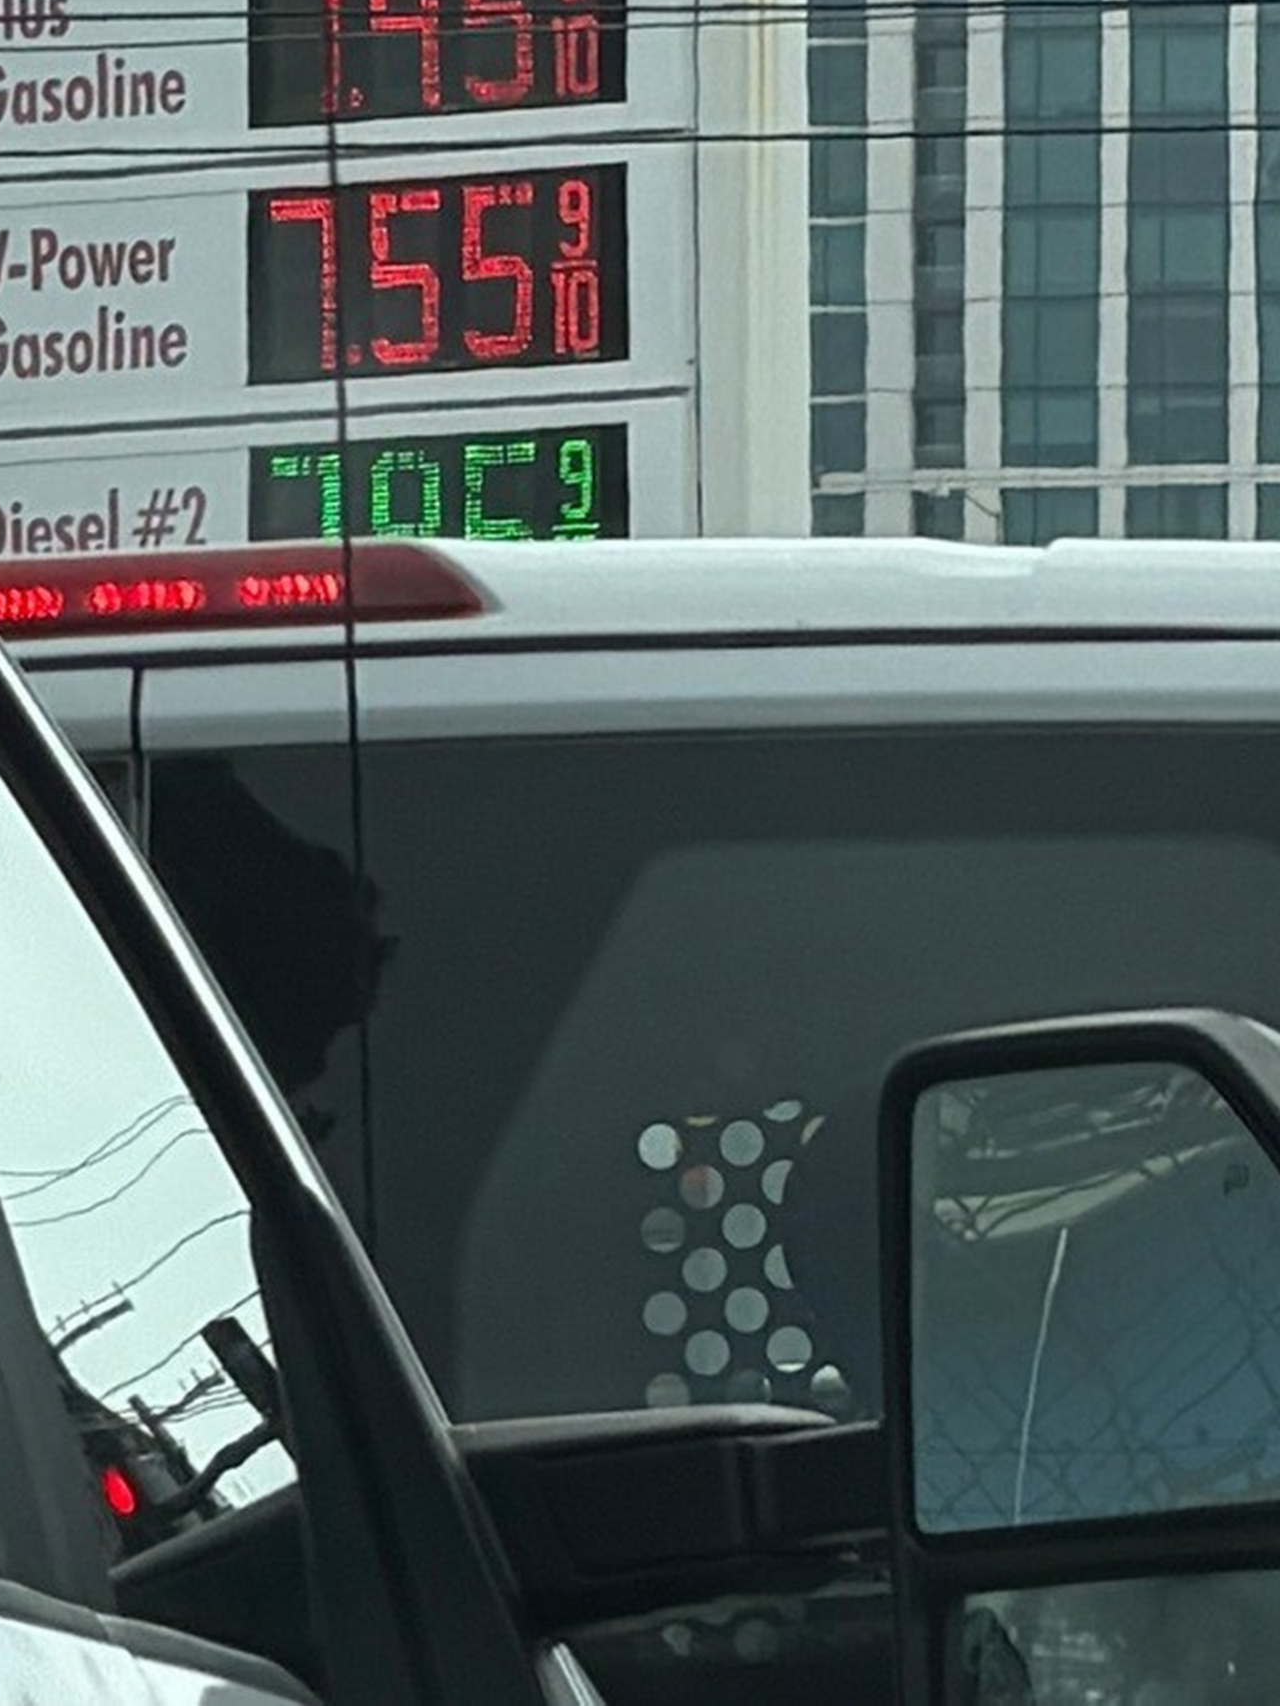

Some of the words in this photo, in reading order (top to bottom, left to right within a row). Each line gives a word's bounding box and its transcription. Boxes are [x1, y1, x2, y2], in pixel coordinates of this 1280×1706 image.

[551, 18, 598, 96] 10
[269, 182, 534, 370] 7.55
[557, 178, 593, 259] 9
[550, 267, 601, 354] 10
[131, 485, 207, 548] #2
[557, 438, 595, 520] 9
